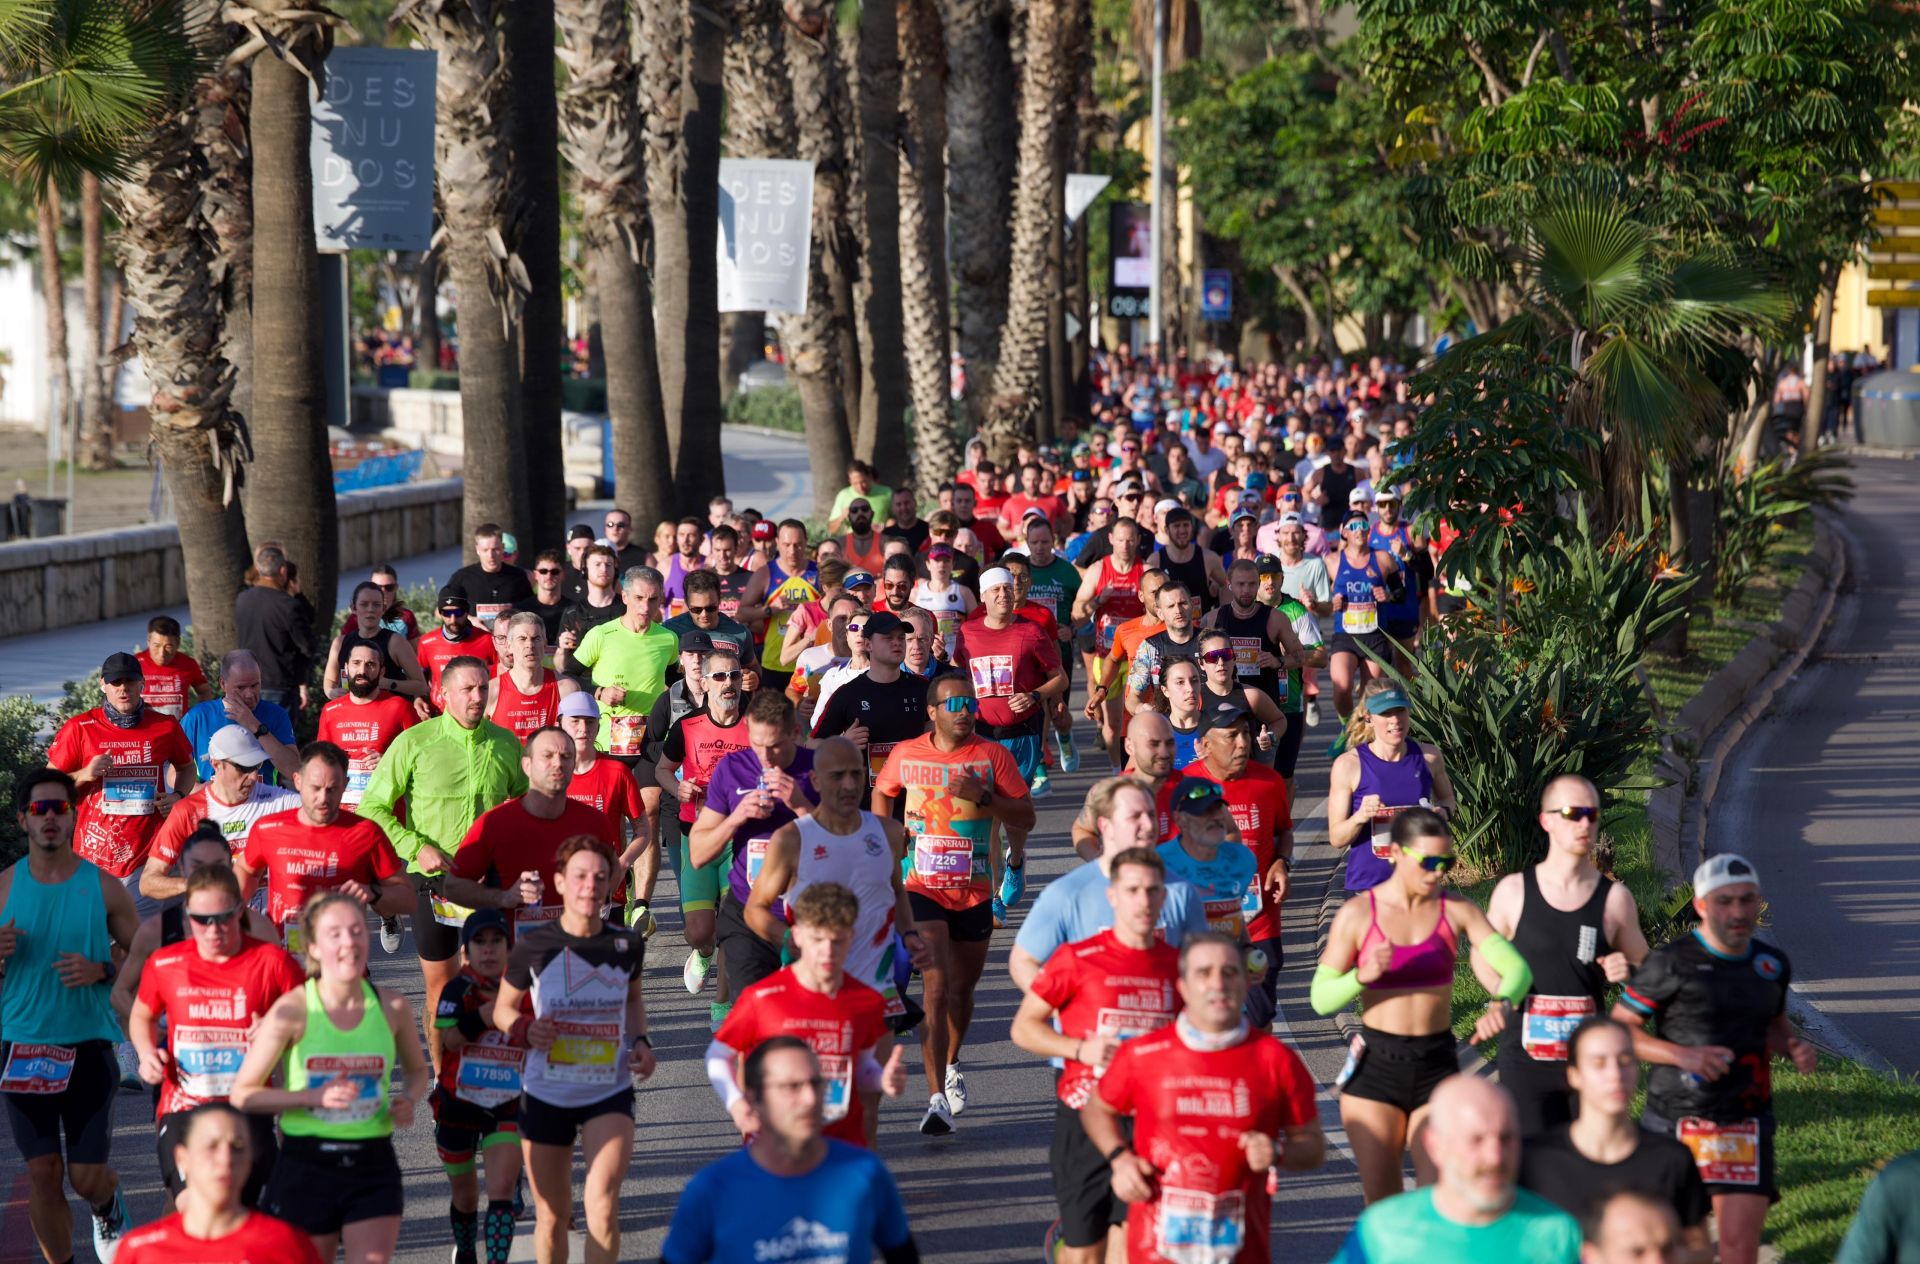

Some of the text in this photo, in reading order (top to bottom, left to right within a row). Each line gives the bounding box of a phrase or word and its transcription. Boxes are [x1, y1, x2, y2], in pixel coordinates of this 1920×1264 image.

[329, 75, 417, 107] DES
[340, 115, 403, 147] NU
[321, 156, 417, 189] DOS
[731, 180, 798, 206] DES
[738, 209, 786, 235] NU
[1346, 581, 1371, 594] RCM
[514, 718, 541, 730] MÁLAGA
[341, 731, 369, 742] MÁLAGA
[108, 741, 141, 749] GENERALI
[119, 768, 155, 777] GENERALI
[902, 763, 943, 786] DARB
[115, 784, 147, 794] 10057
[933, 840, 968, 849] GENERALI
[930, 854, 957, 866] 7226
[285, 862, 325, 878] MÁLAGA
[188, 1002, 233, 1020] MÁLAGA
[189, 1051, 233, 1066] 11842
[474, 1066, 511, 1082] 17850
